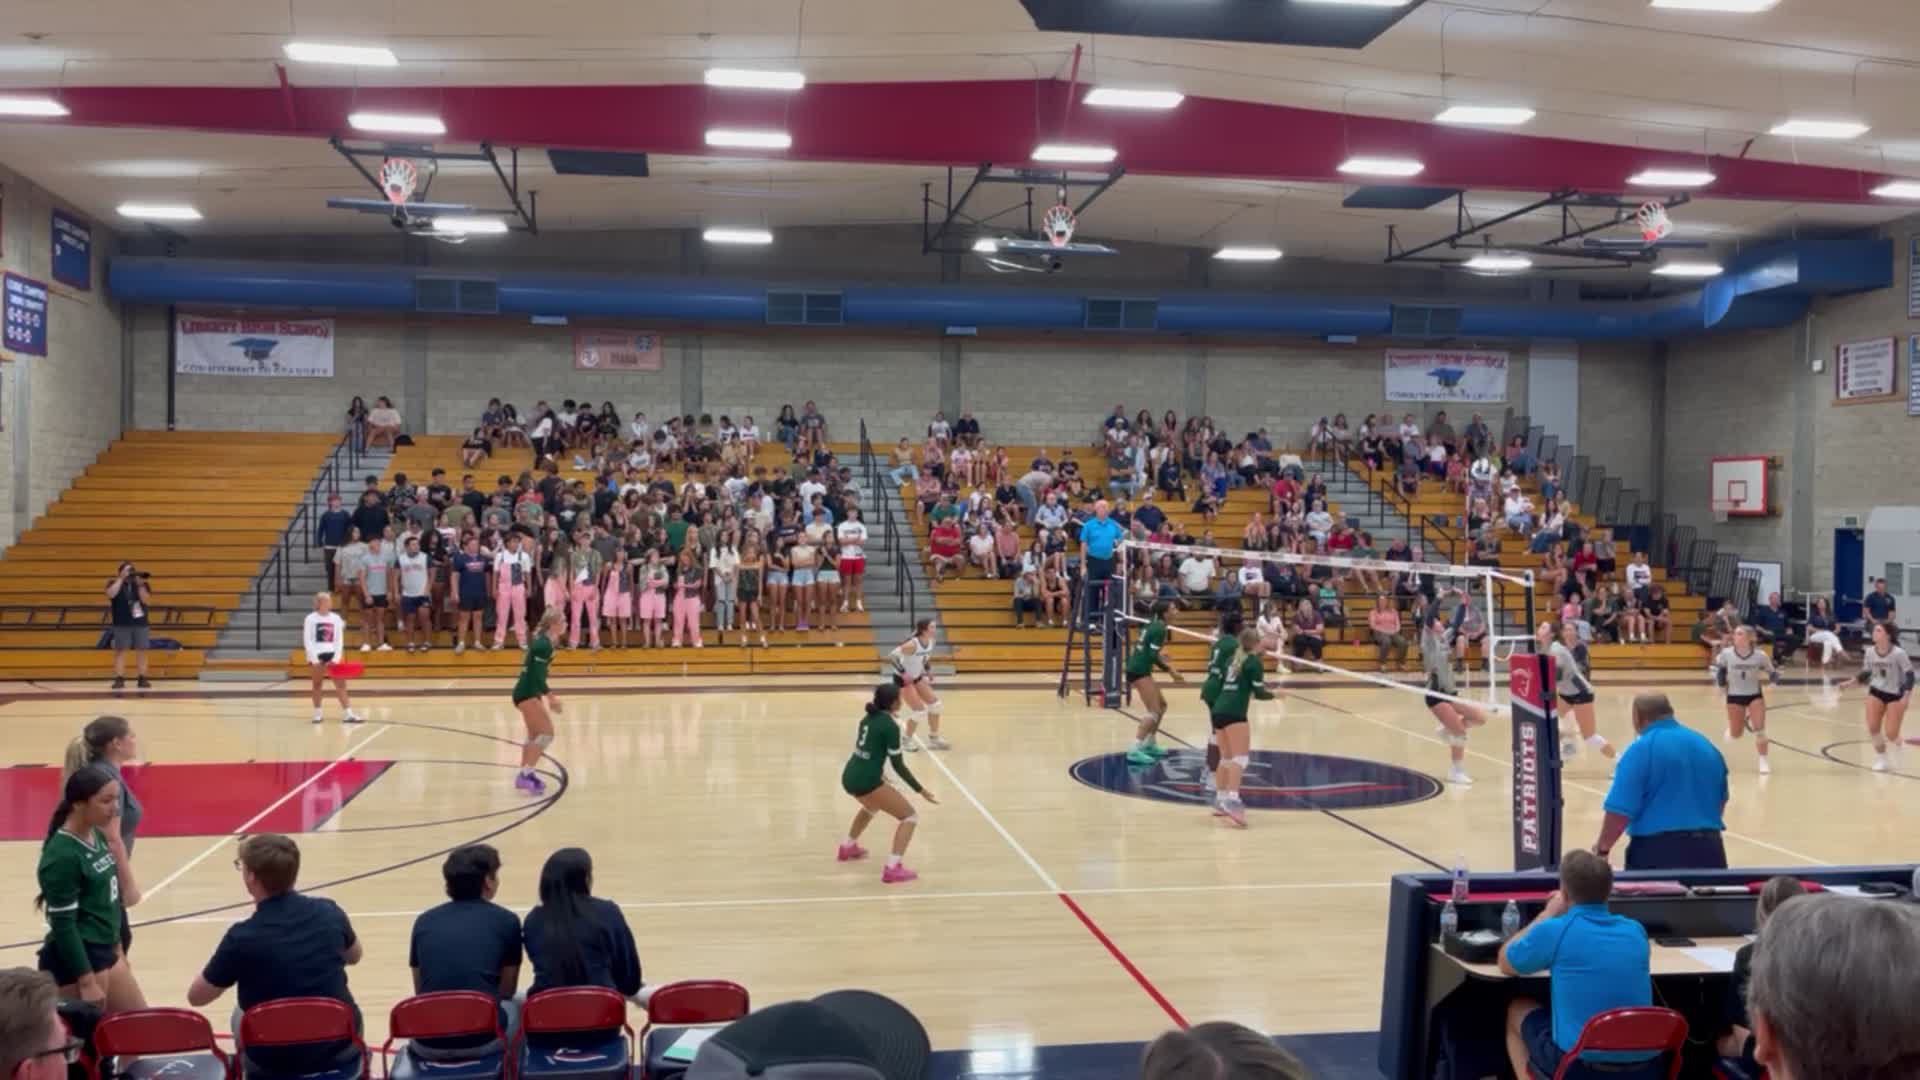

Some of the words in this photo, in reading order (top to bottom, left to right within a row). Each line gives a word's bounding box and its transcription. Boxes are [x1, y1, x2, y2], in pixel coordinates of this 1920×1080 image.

[858, 725, 869, 746] 3
[1520, 724, 1539, 854] PATRIOTS
[110, 874, 119, 902] 8
